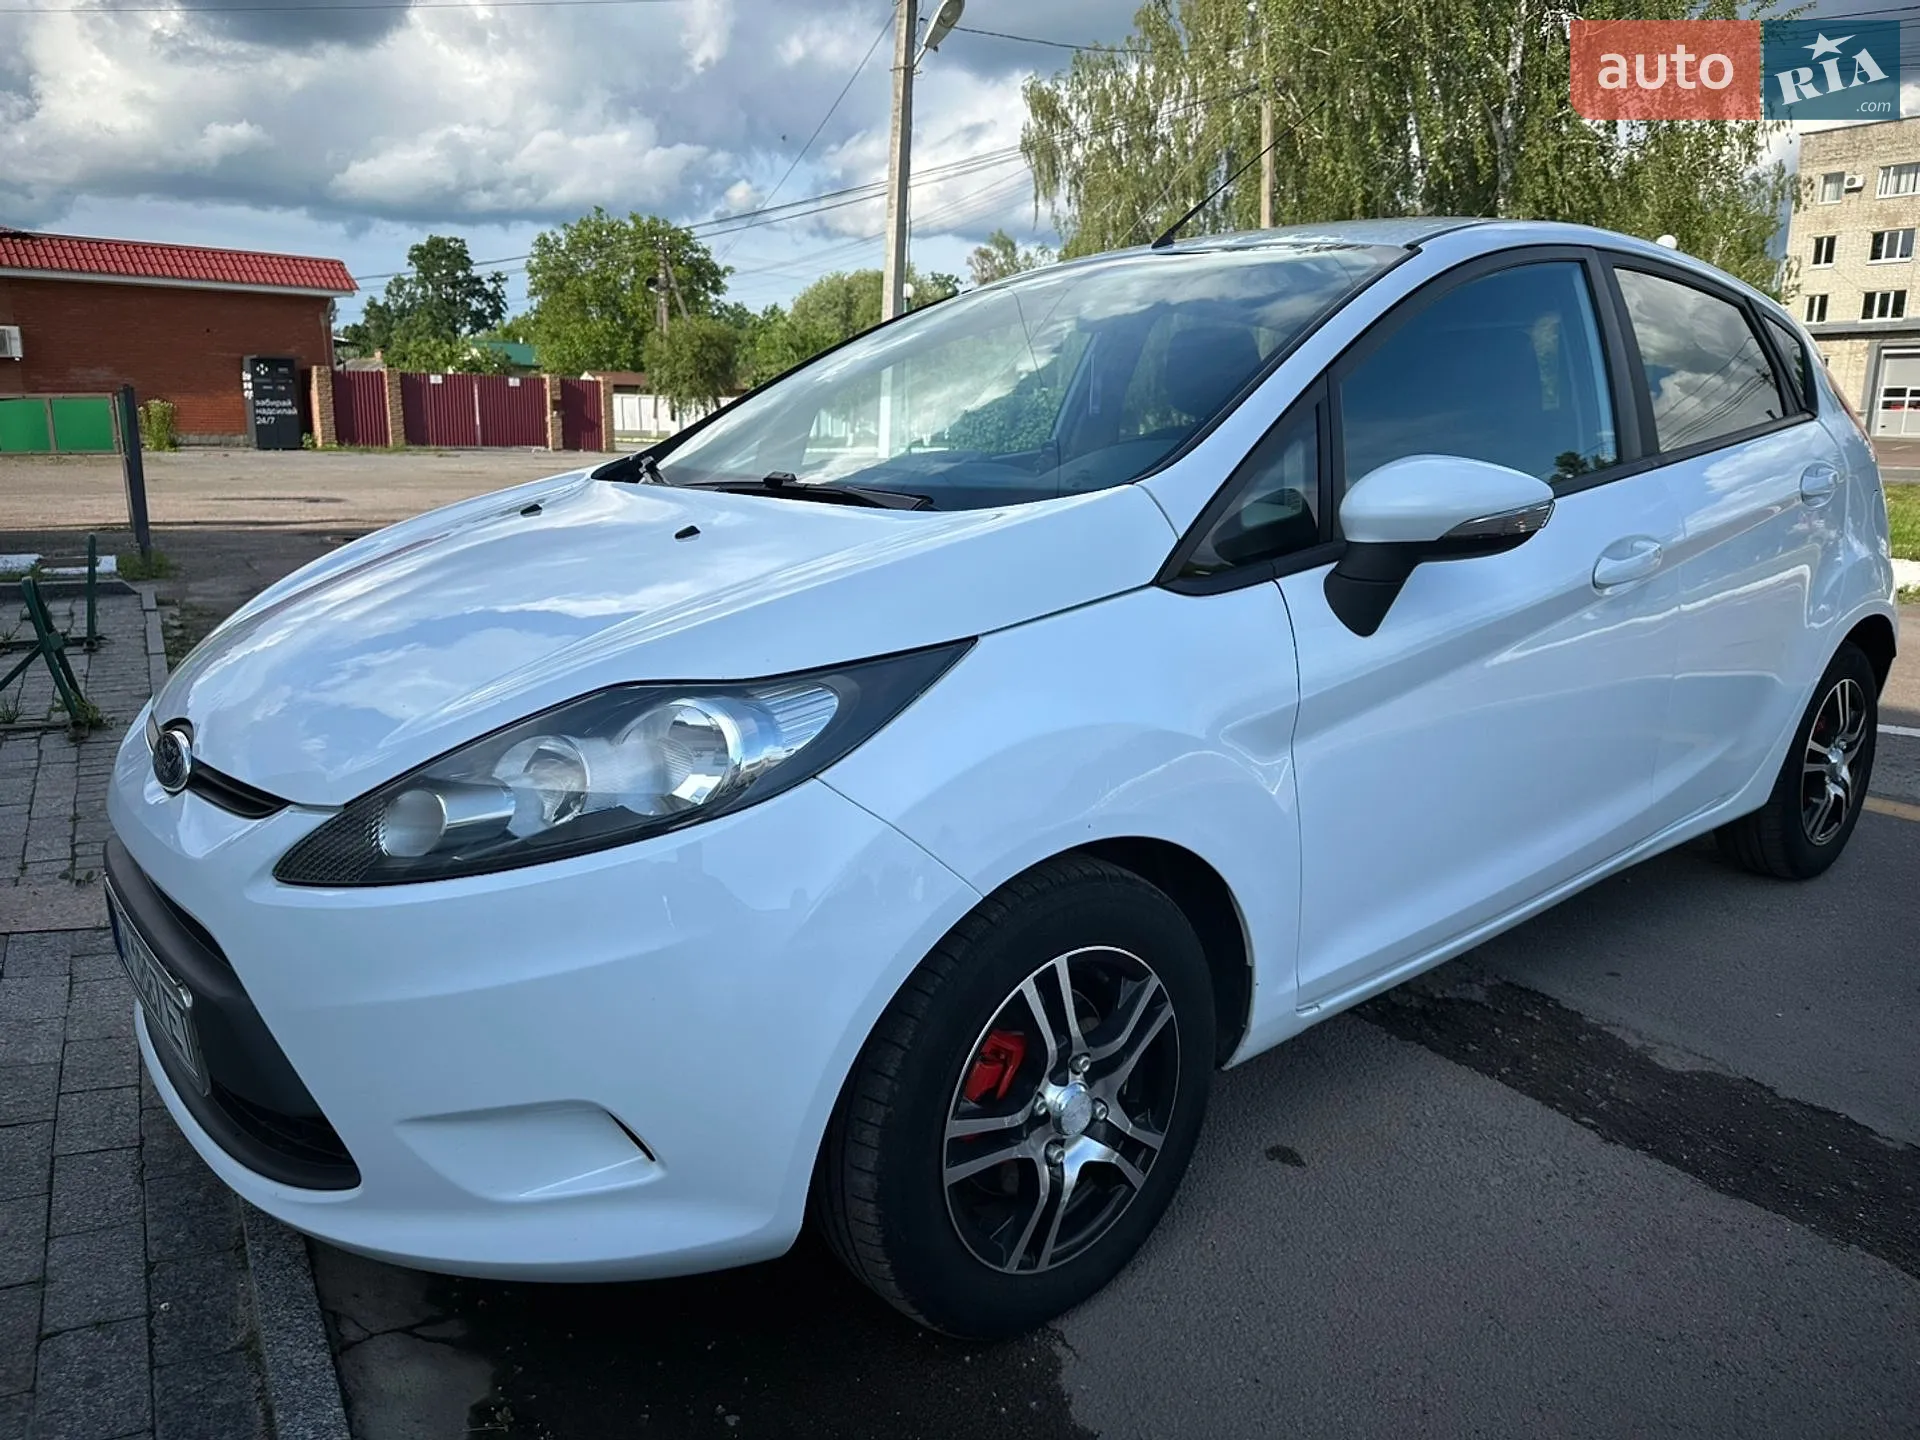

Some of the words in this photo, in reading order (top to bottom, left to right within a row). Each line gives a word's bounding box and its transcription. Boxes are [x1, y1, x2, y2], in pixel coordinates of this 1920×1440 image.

[255, 399, 292, 407] забирай
[255, 407, 298, 415] надсилай
[255, 416, 275, 424] 24/7
